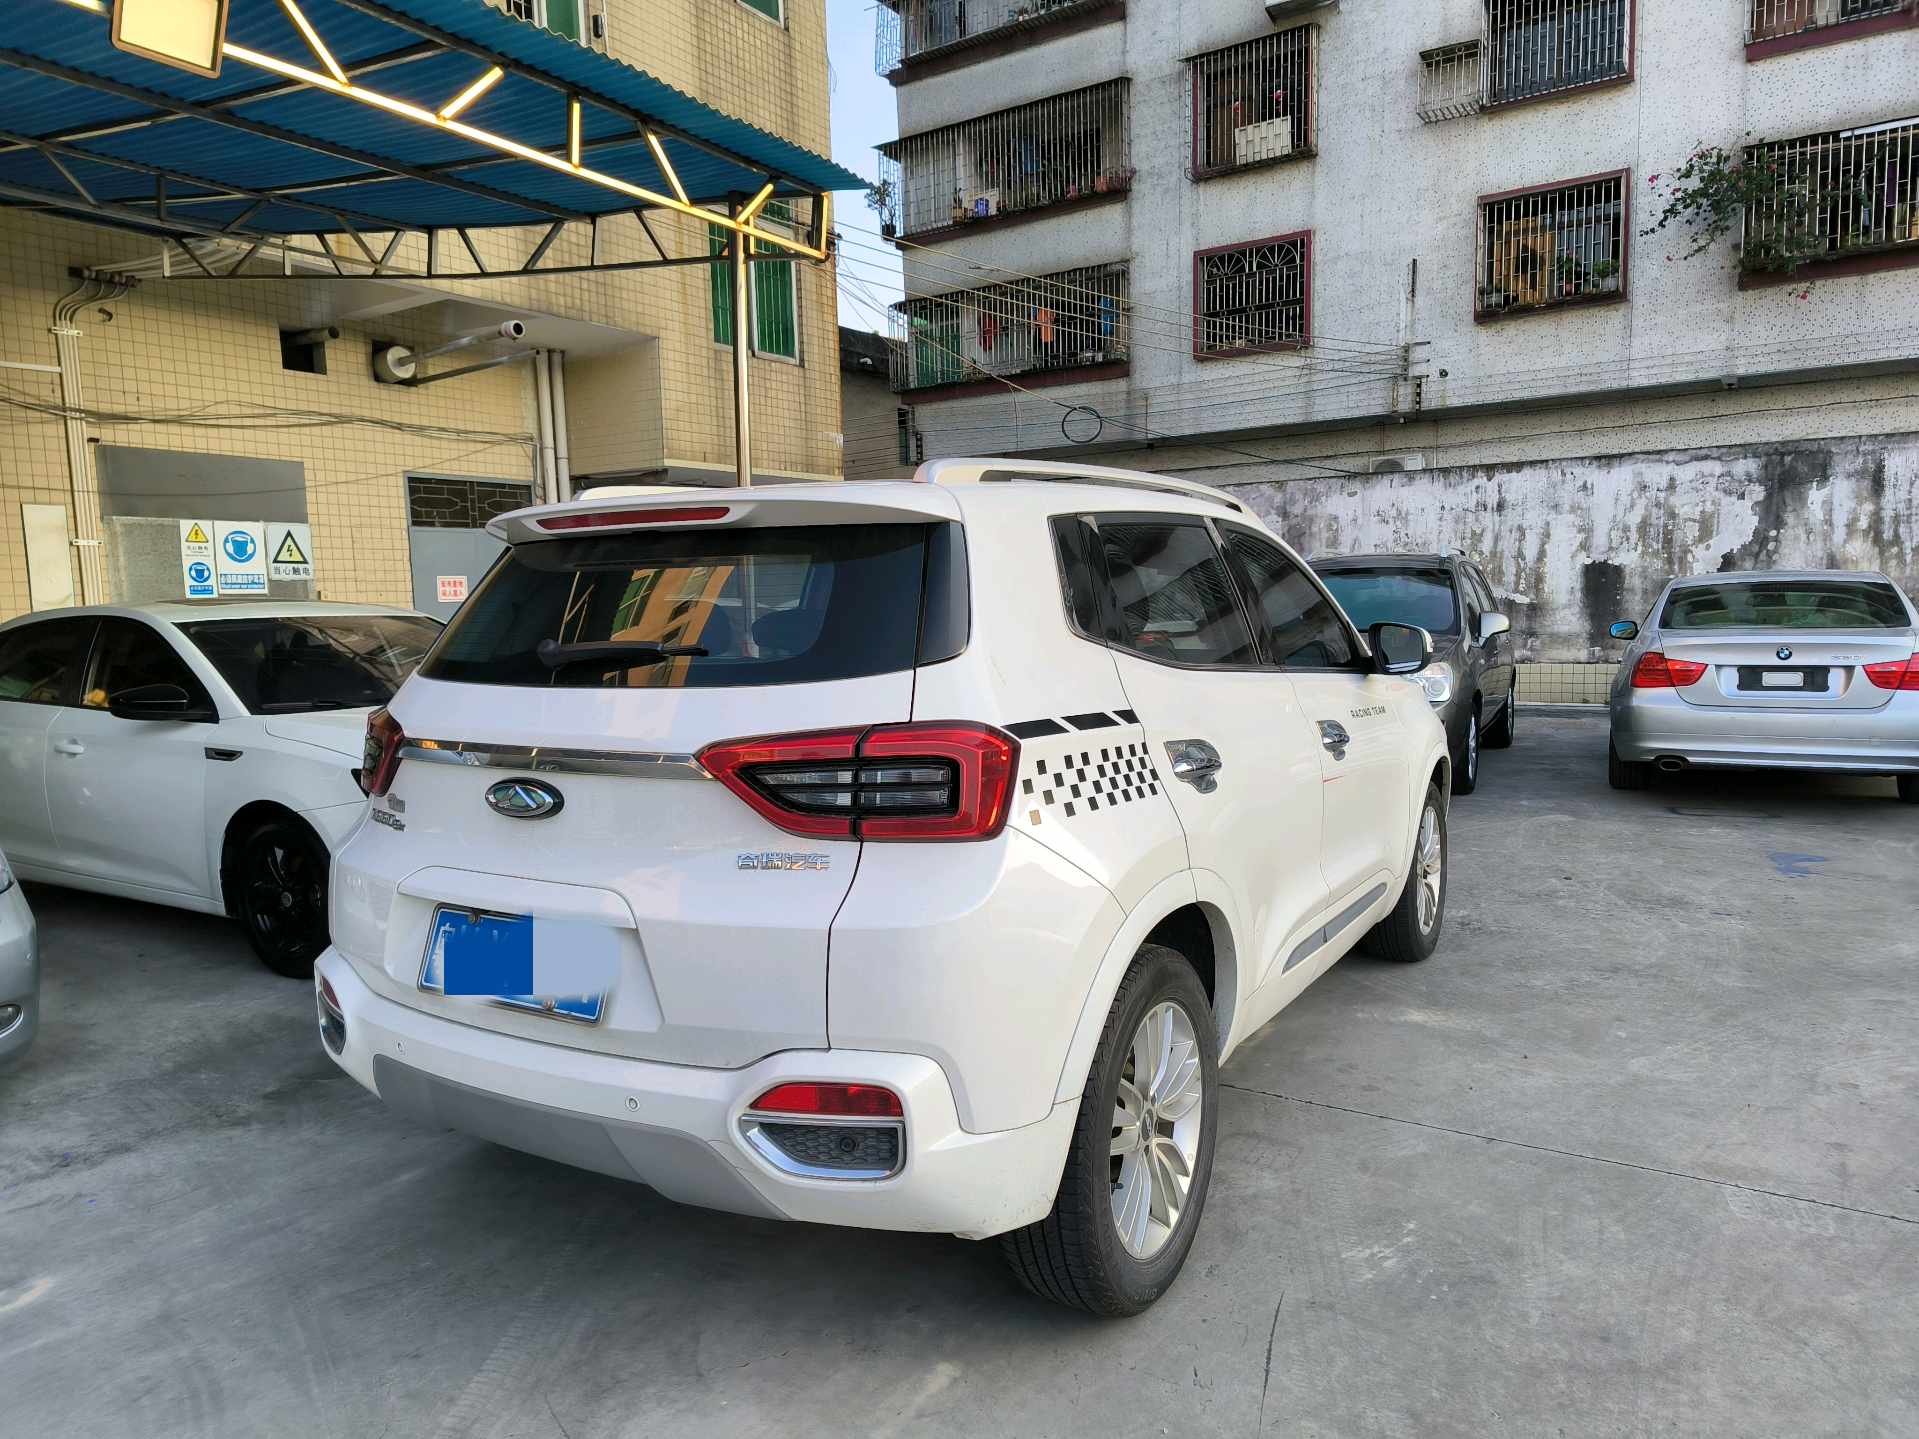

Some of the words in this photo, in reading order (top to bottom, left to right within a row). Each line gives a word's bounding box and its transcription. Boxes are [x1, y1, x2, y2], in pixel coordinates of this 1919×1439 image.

[273, 565, 311, 576] 当心触电
[1350, 707, 1372, 718] RACING
[1372, 705, 1387, 716] TEAM
[737, 852, 831, 870] 奇瑞汽车
